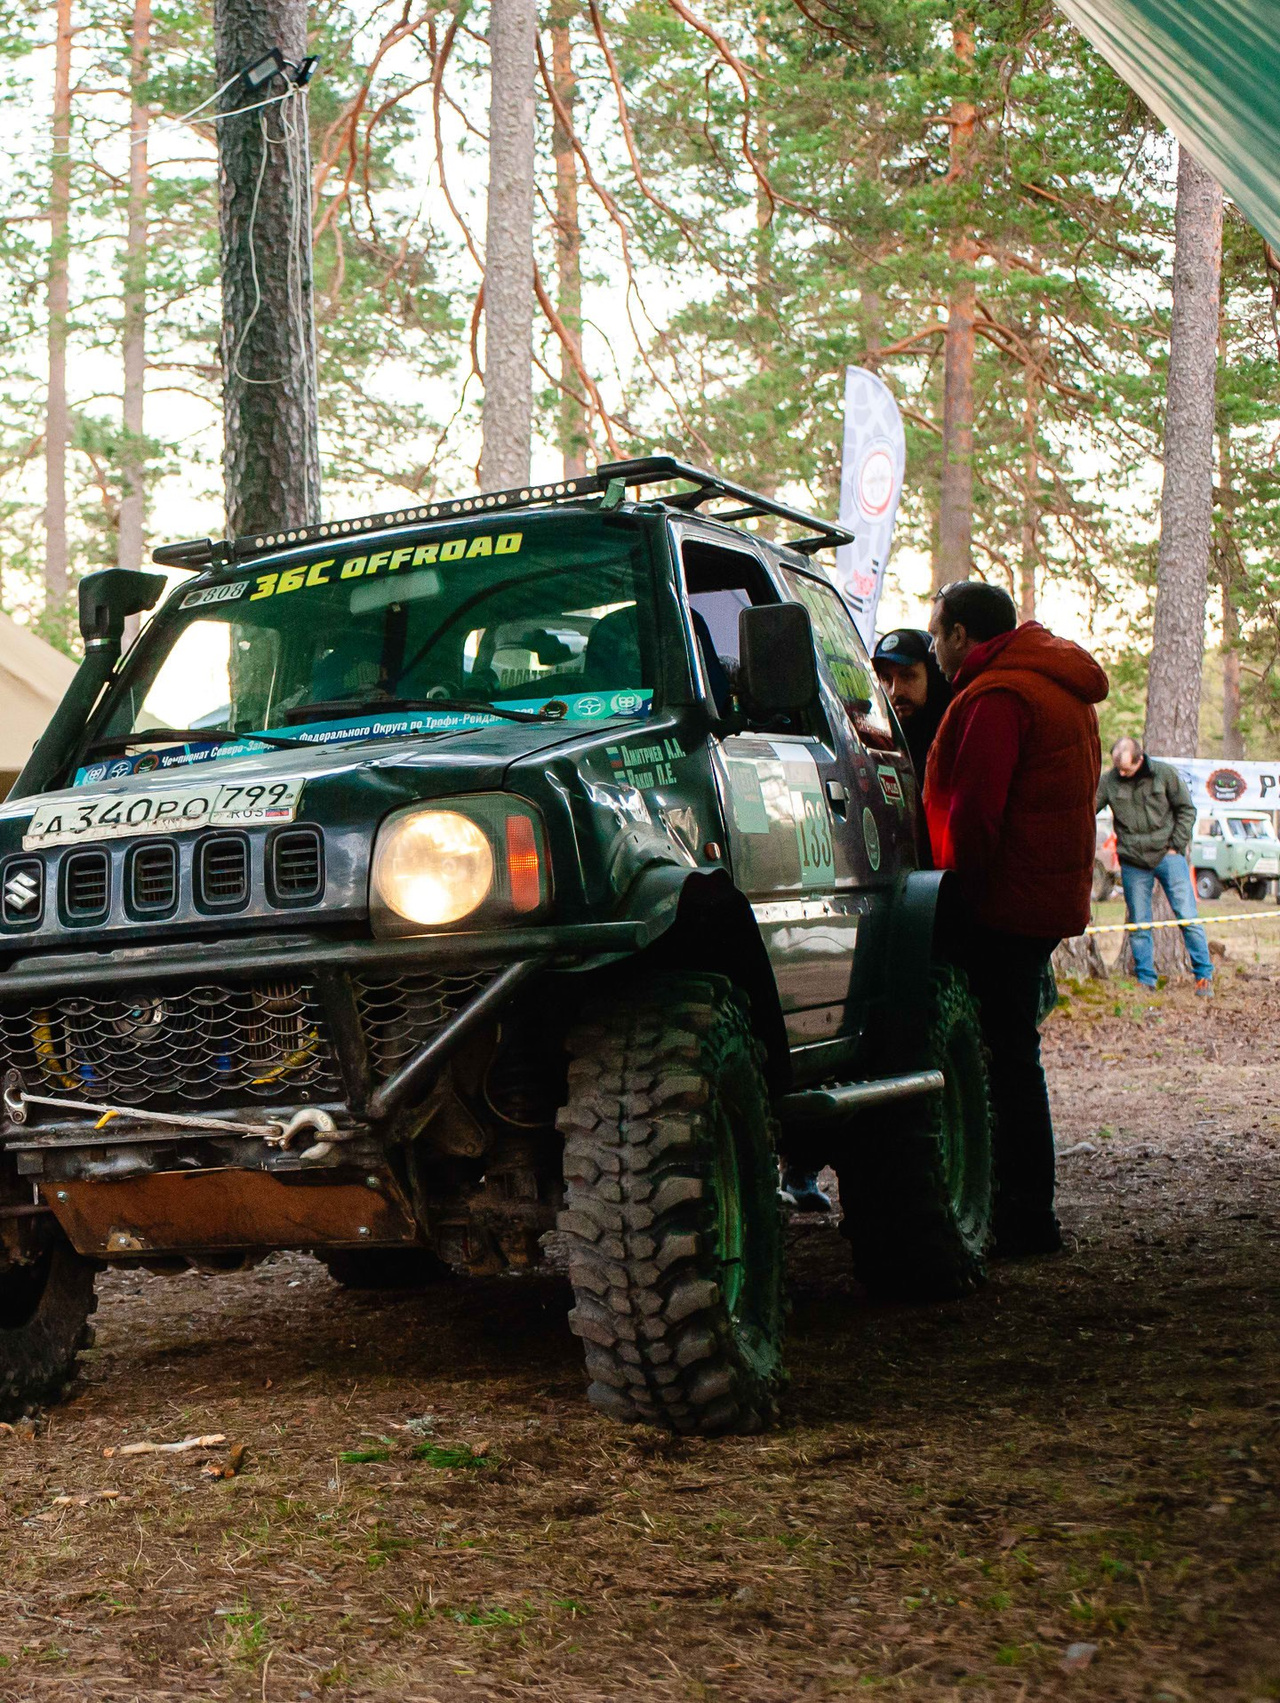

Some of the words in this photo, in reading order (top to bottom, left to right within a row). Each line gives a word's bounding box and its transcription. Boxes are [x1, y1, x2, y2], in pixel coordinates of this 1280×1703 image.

[340, 532, 523, 580] OFFROAD
[203, 583, 244, 602] 808
[372, 720, 408, 736] Округа
[222, 783, 289, 809] 799
[231, 808, 265, 819] RUS
